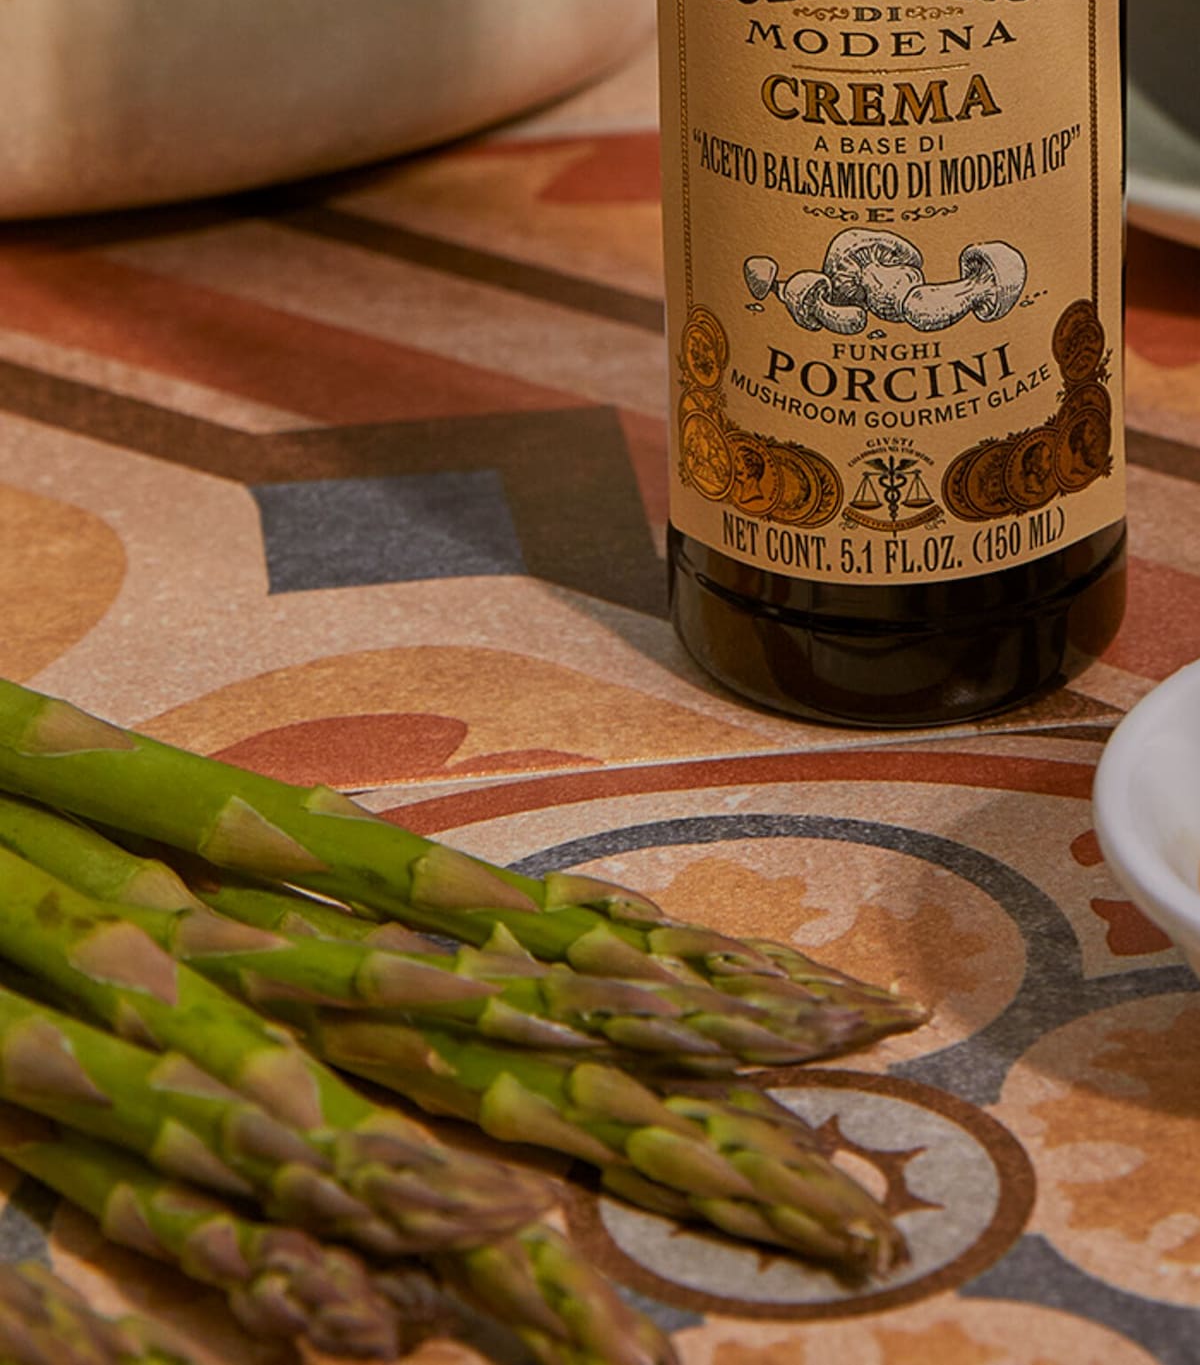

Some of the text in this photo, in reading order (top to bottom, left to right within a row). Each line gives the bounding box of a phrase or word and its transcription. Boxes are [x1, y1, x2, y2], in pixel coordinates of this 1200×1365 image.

[853, 7, 901, 22] DI
[745, 19, 1017, 57] MODENA
[760, 73, 1002, 127] CREMA
[814, 136, 944, 155] A BASE DI
[764, 152, 899, 200] BALSAMICO
[907, 161, 932, 199] DI
[941, 148, 1036, 195] MODENA
[866, 208, 895, 223] E
[763, 342, 1016, 404] PORCINI
[832, 342, 942, 361] FUNGHI
[730, 363, 1052, 429] MUSHROOM GOURMET GLAZE
[722, 506, 1066, 575] NET CONT. 5.1 FL.OZ. (150 ML)
